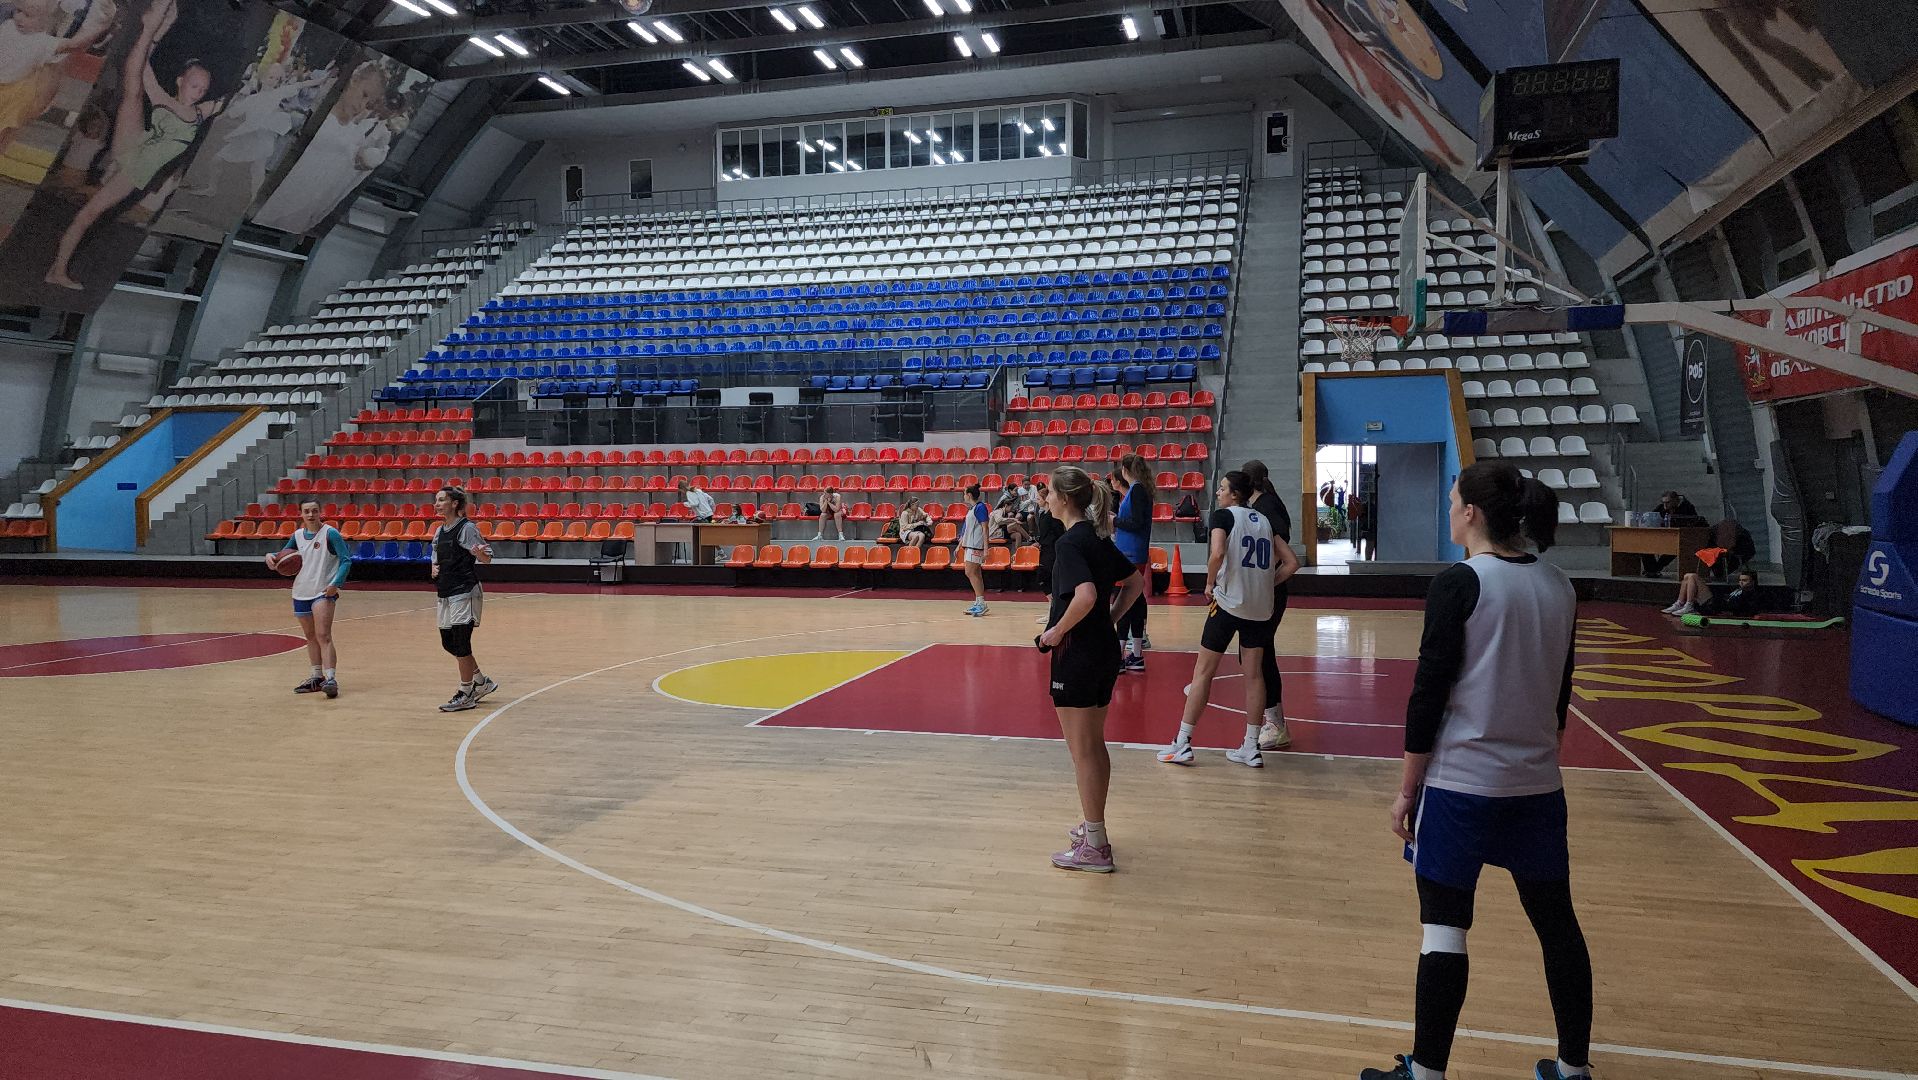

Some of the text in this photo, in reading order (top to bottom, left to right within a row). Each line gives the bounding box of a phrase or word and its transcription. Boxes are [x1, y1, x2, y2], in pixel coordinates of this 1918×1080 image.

[1507, 129, 1541, 141] MegaS
[1688, 362, 1703, 381] РФБ
[1241, 535, 1271, 570] 20
[1880, 588, 1902, 599] Sports
